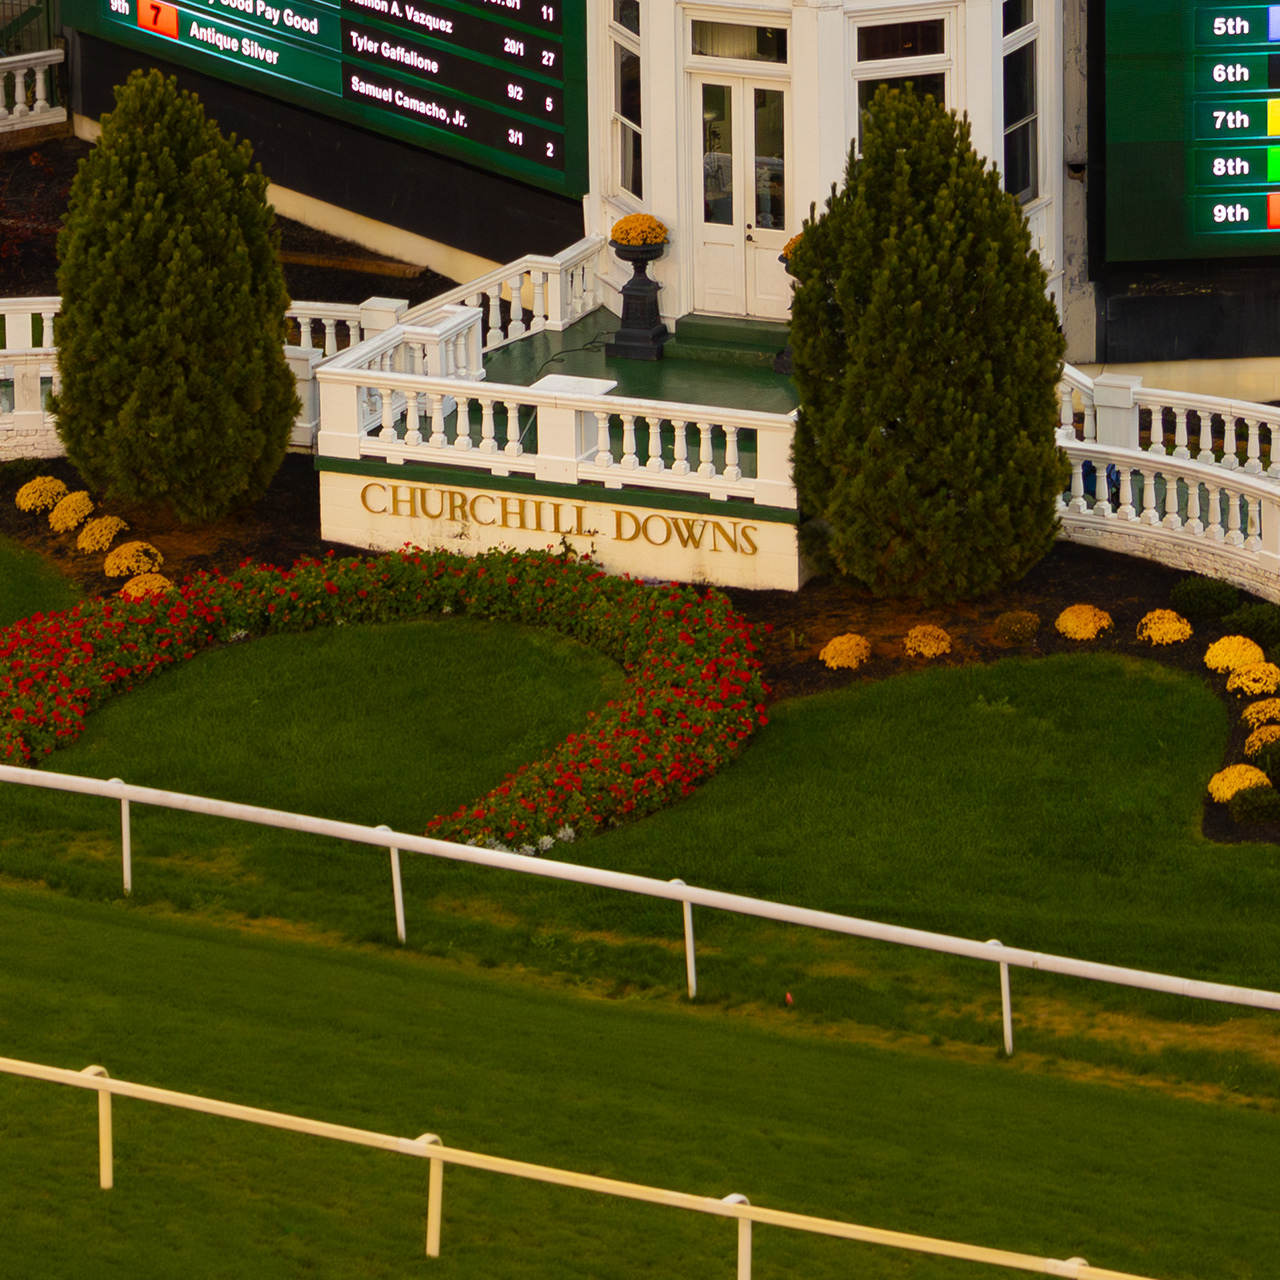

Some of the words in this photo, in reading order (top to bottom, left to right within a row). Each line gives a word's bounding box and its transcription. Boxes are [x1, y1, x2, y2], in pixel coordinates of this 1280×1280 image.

[256, 0, 281, 26] Pay
[283, 8, 318, 35] Good
[1213, 16, 1250, 36] 5th
[189, 21, 239, 52] Antique
[241, 37, 279, 65] Silver
[1212, 63, 1249, 83] 6th
[1212, 110, 1249, 129] 7th
[1212, 157, 1249, 176] 8th
[1213, 203, 1250, 223] 9th
[360, 482, 600, 537] CHURCHILL
[611, 509, 758, 556] DOWNS
